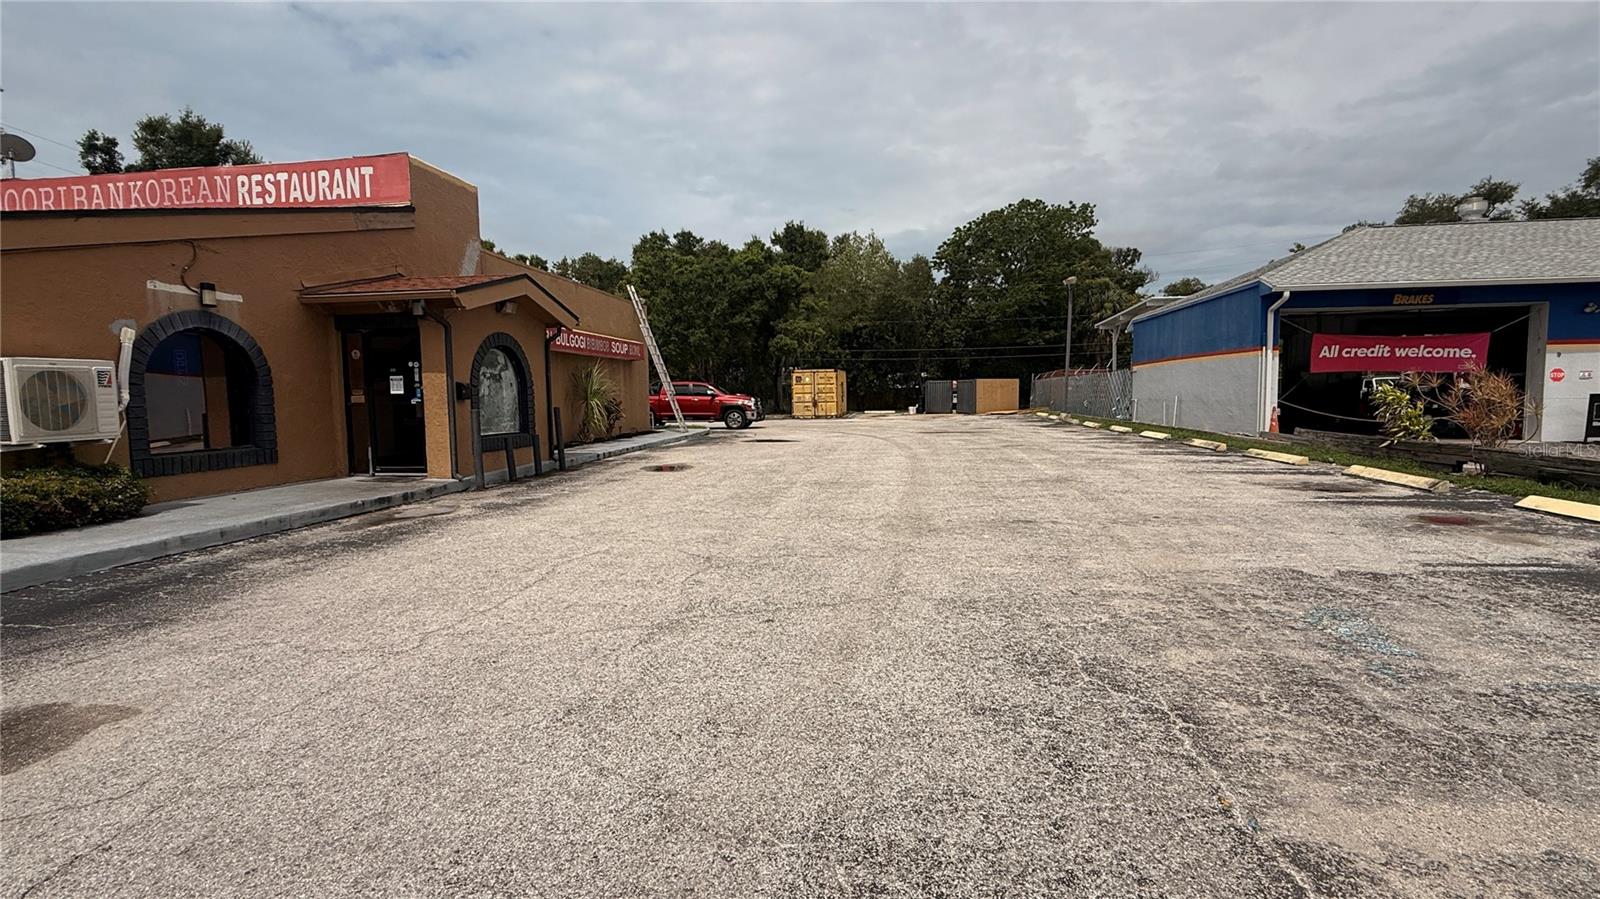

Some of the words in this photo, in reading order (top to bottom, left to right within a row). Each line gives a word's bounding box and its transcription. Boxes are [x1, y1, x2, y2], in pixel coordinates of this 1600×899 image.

[237, 166, 374, 206] RESTAURANT
[1392, 294, 1434, 304] BRAKES
[611, 341, 628, 354] SOUP
[1319, 345, 1338, 358] All
[1342, 344, 1391, 358] credit
[1395, 344, 1477, 358] welcome.
